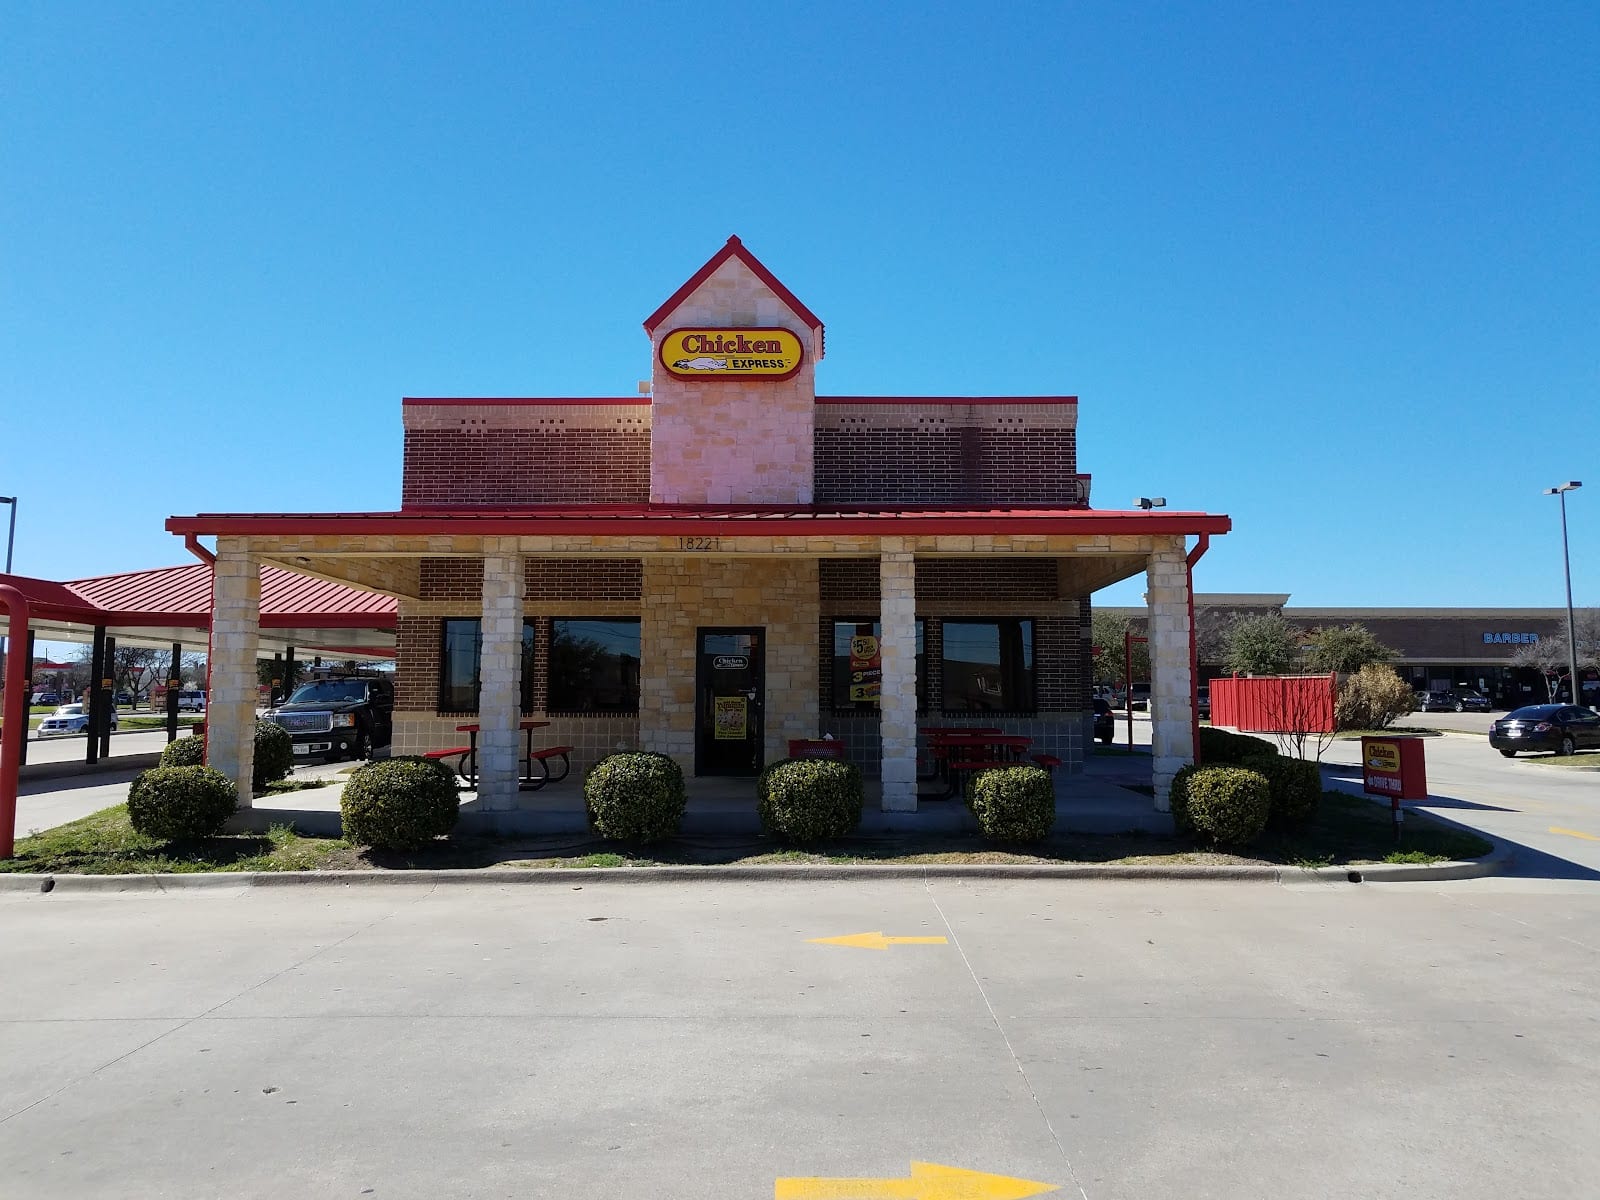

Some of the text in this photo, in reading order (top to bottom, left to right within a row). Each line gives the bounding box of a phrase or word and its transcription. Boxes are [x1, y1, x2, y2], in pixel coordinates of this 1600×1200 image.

[681, 334, 783, 354] Chicken
[732, 359, 785, 369] EXPRESS
[679, 537, 719, 550] 18221
[1483, 632, 1539, 644] BARBER
